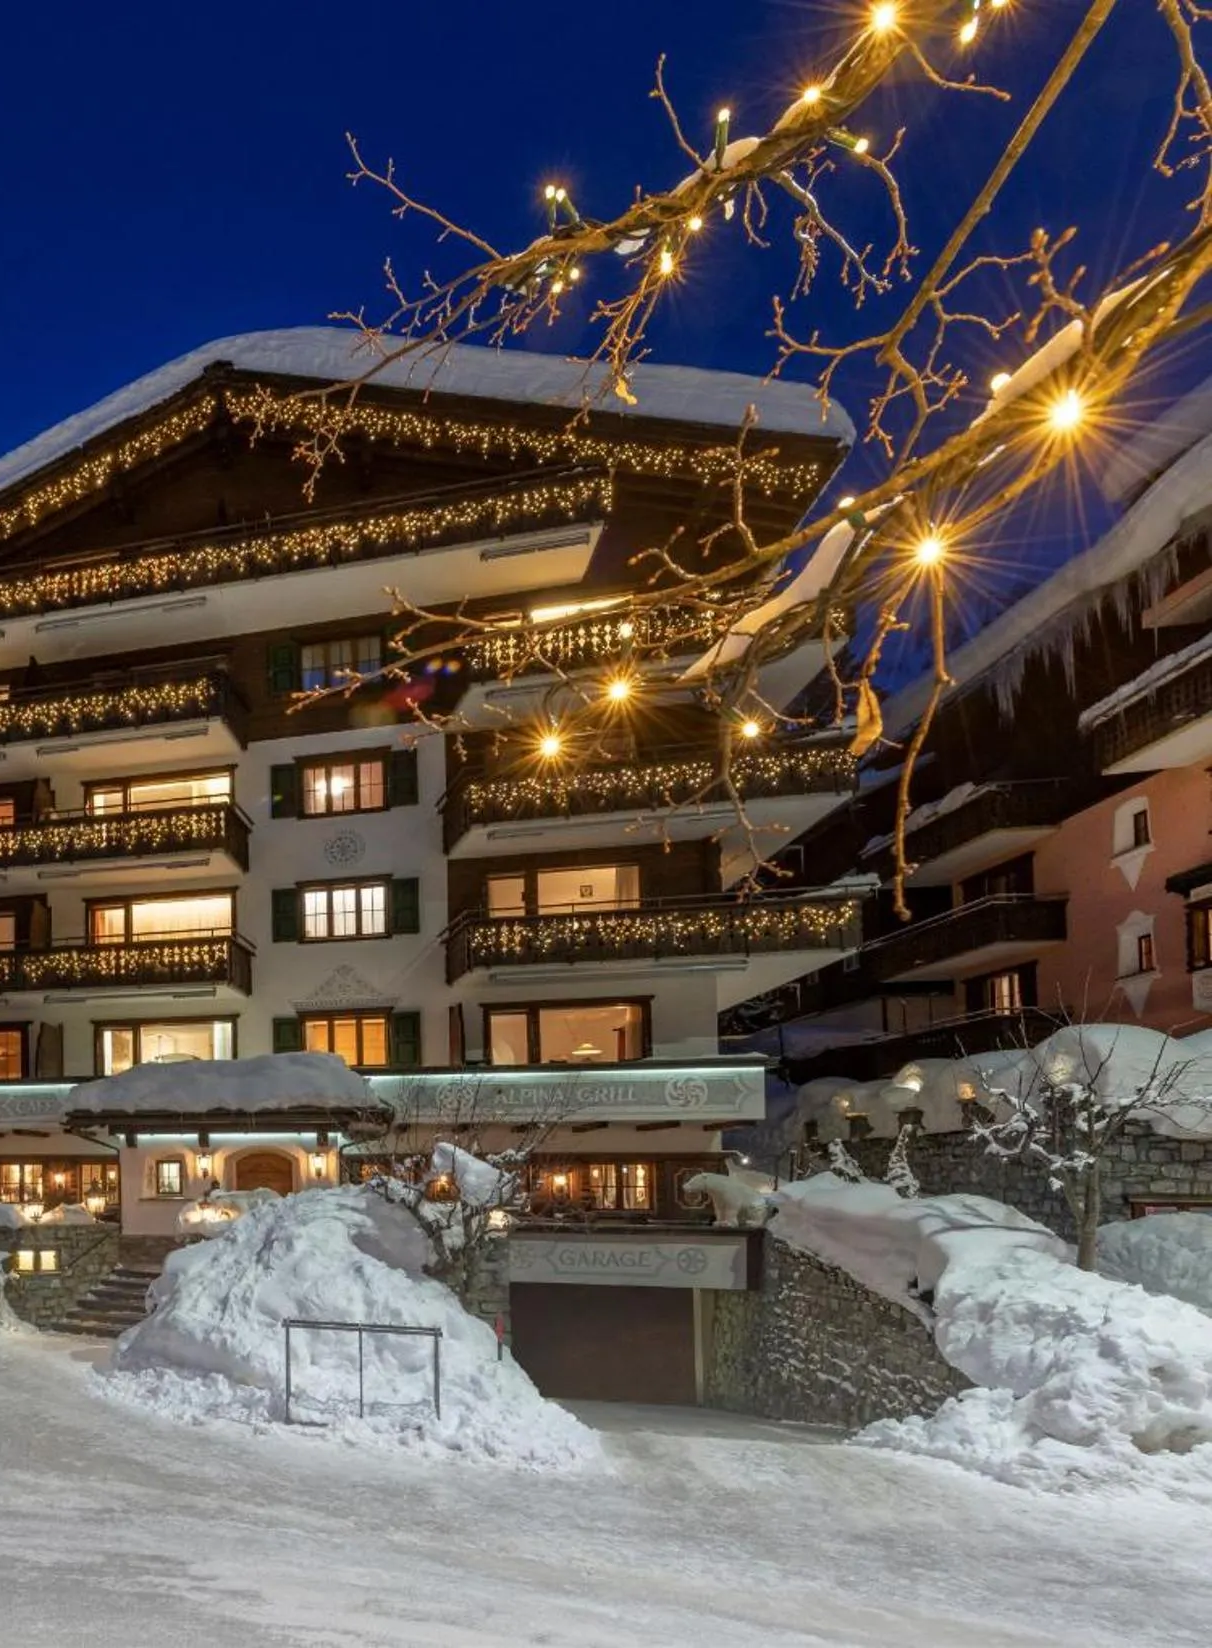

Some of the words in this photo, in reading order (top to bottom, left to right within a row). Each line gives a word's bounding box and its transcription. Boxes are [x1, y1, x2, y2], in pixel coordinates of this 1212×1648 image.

[494, 1087, 565, 1105] ALPINA
[577, 1084, 638, 1104] GRILL
[558, 1248, 653, 1268] GARAGE
